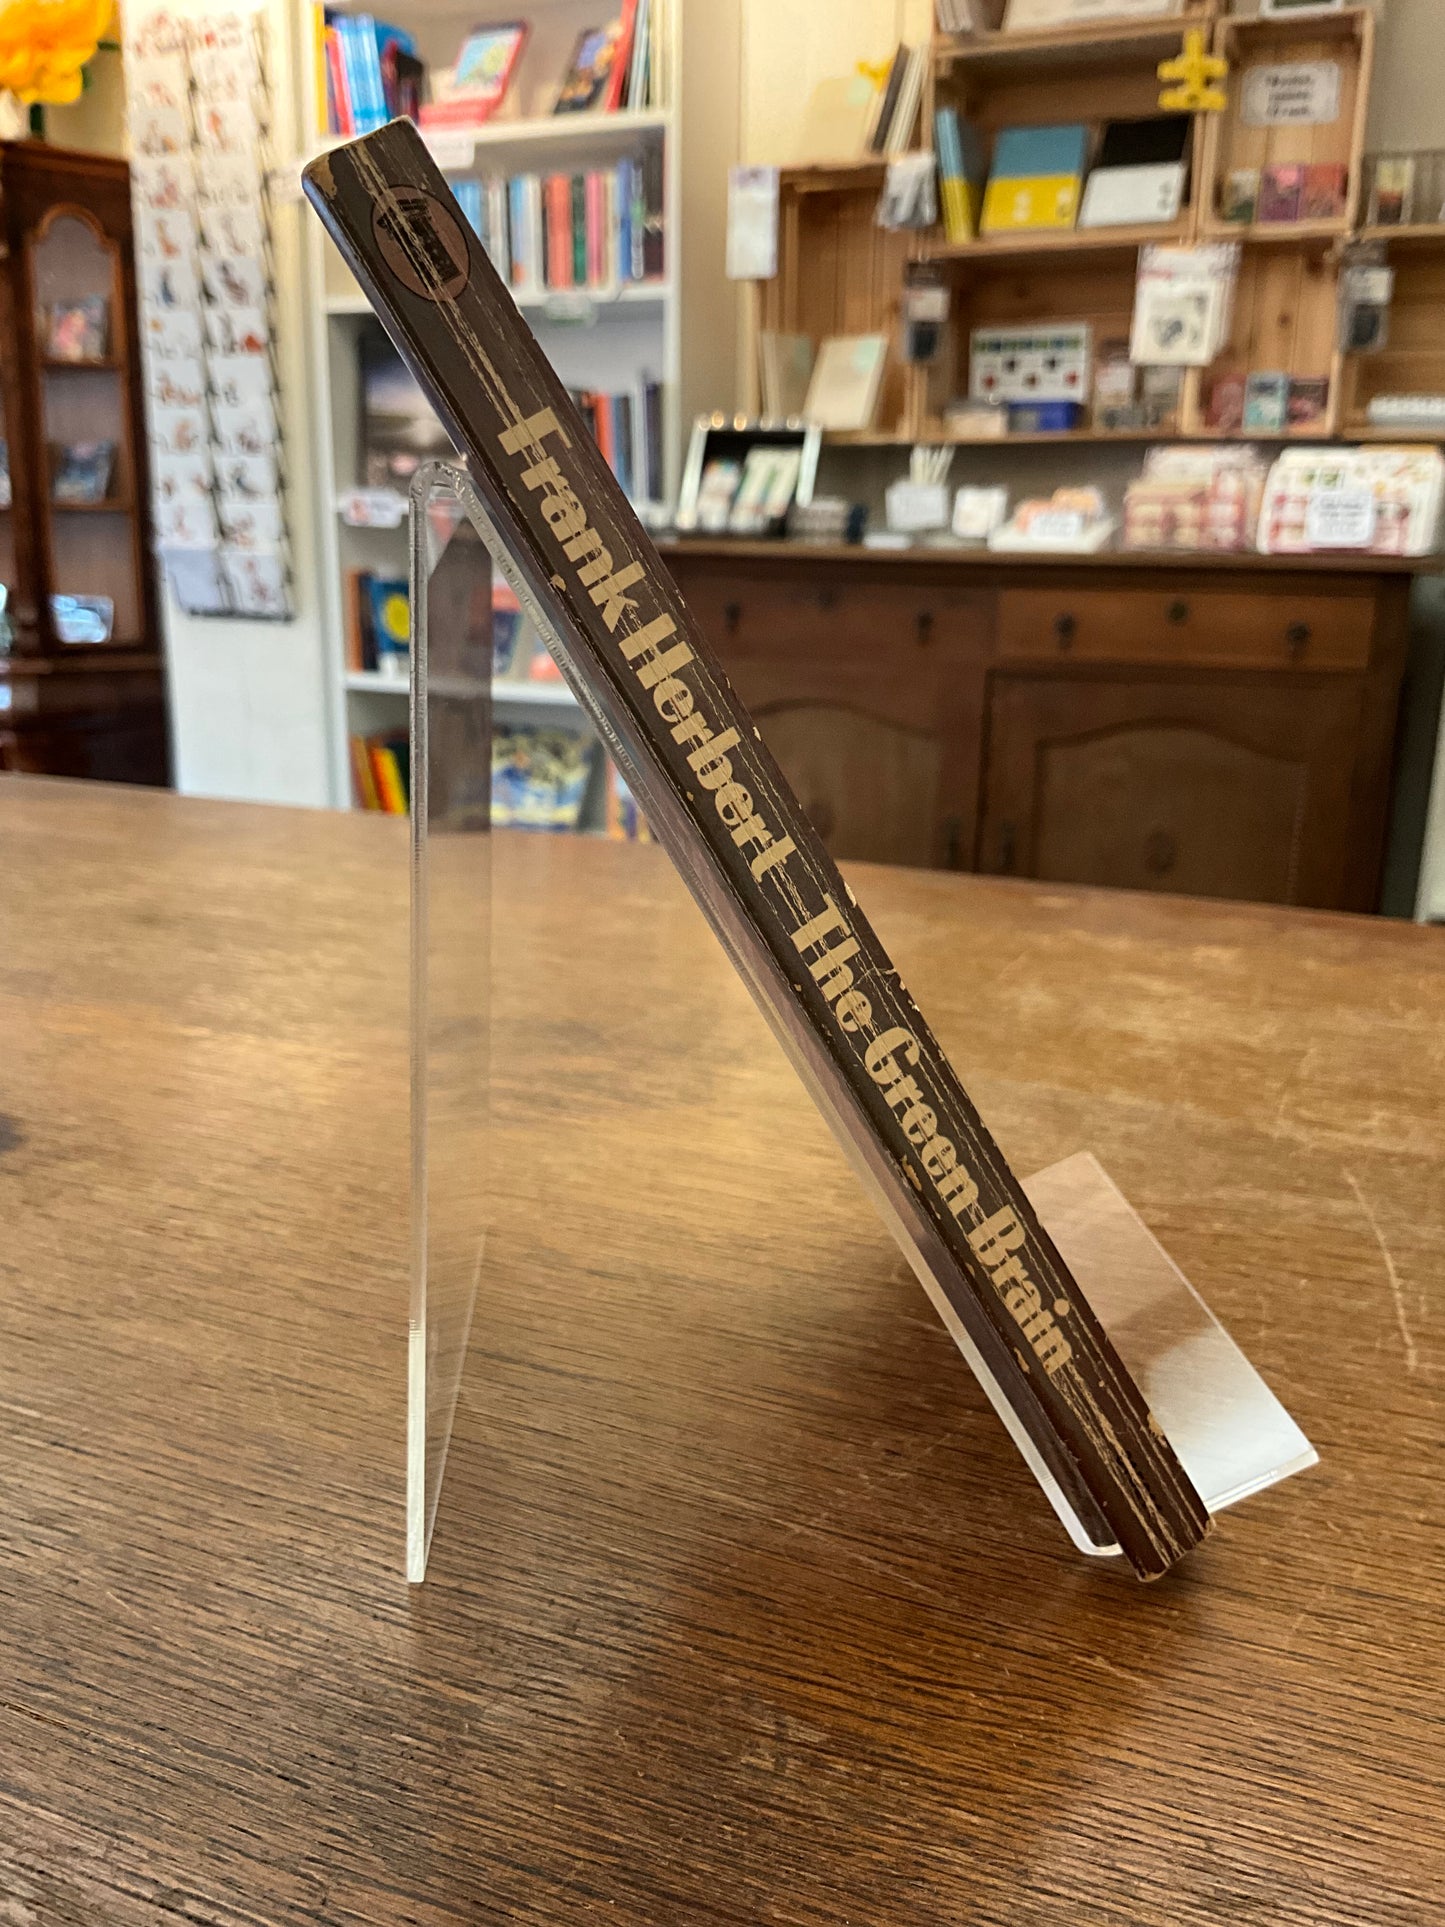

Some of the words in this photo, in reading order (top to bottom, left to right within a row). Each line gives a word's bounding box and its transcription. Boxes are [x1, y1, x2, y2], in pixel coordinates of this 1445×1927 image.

[498, 407, 646, 633] Frank
[619, 613, 796, 882] Herbert
[790, 893, 873, 1032] The
[865, 1027, 979, 1216] Green
[967, 1205, 1072, 1375] Brain
